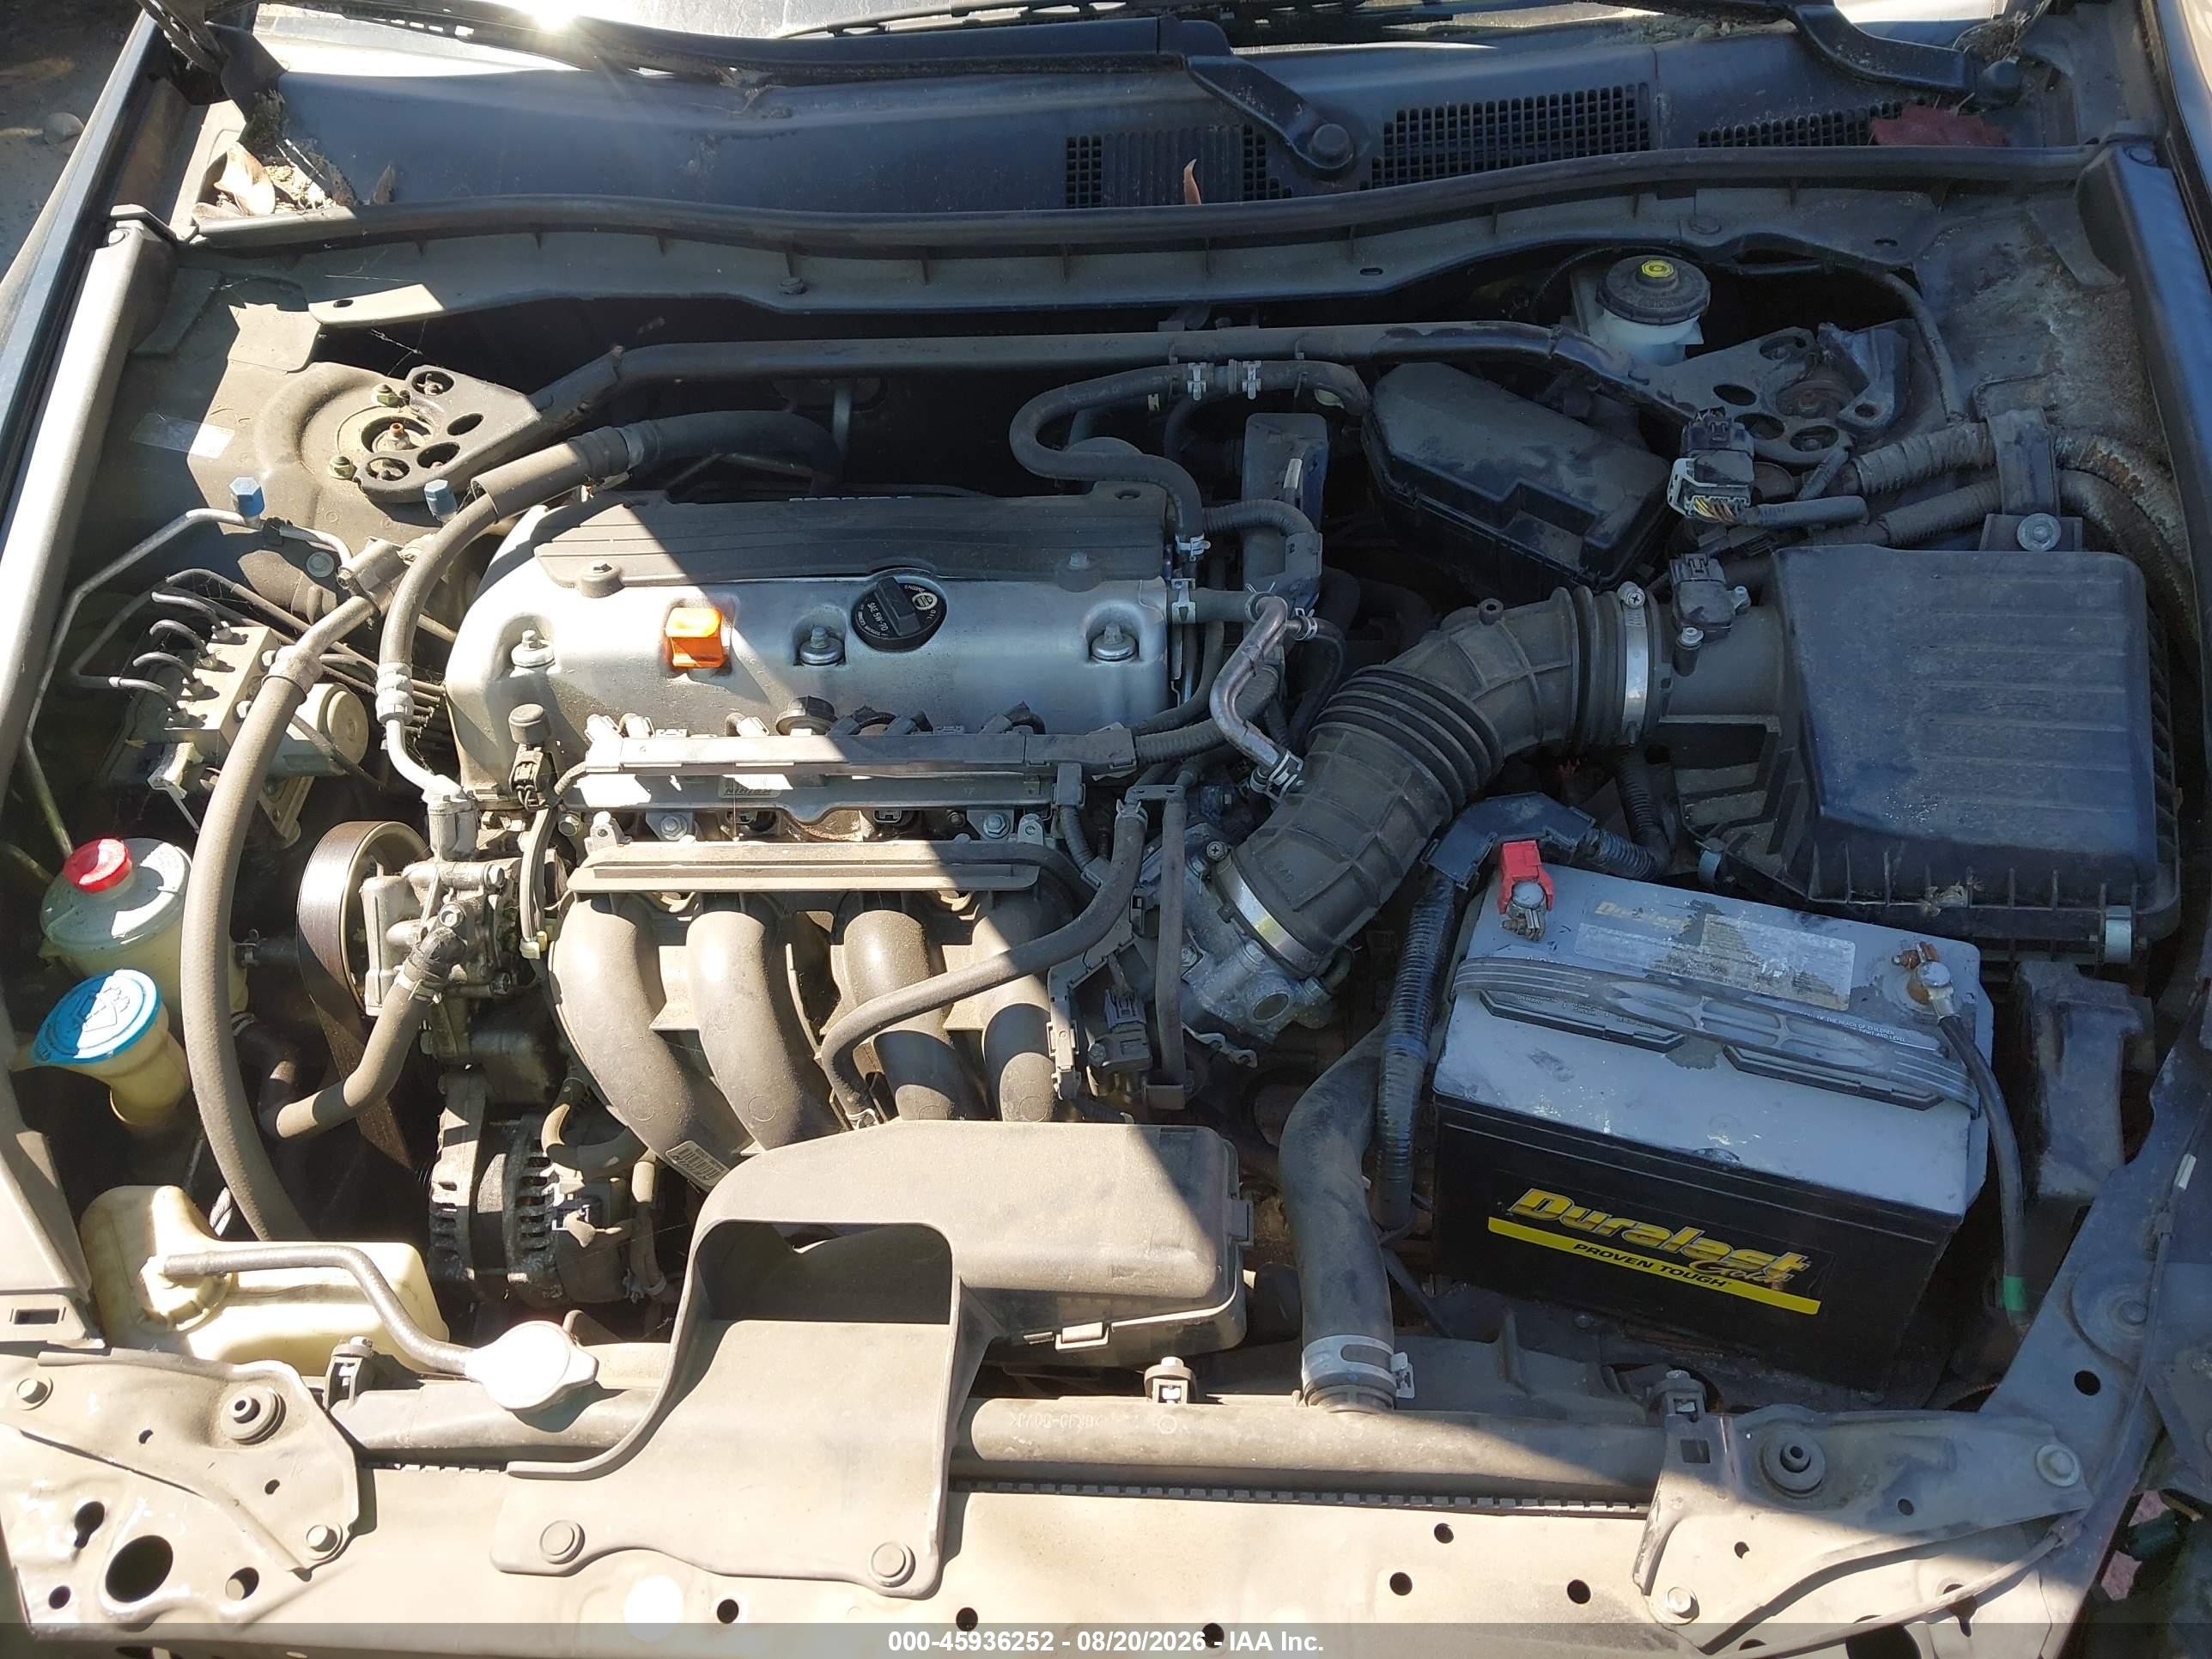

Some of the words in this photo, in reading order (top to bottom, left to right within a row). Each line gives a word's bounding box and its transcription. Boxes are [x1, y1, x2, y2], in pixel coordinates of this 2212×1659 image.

[867, 602, 879, 613] SAE
[927, 609, 937, 620] OIL
[872, 611, 889, 632] 5W-20
[1867, 1024, 1895, 1036] CHILDREN
[1889, 1034, 1906, 1042] LEVEL
[1507, 1188, 1812, 1283] Duralast
[1572, 1243, 1654, 1268] PROVEN
[1659, 1264, 1727, 1287] TOUGH
